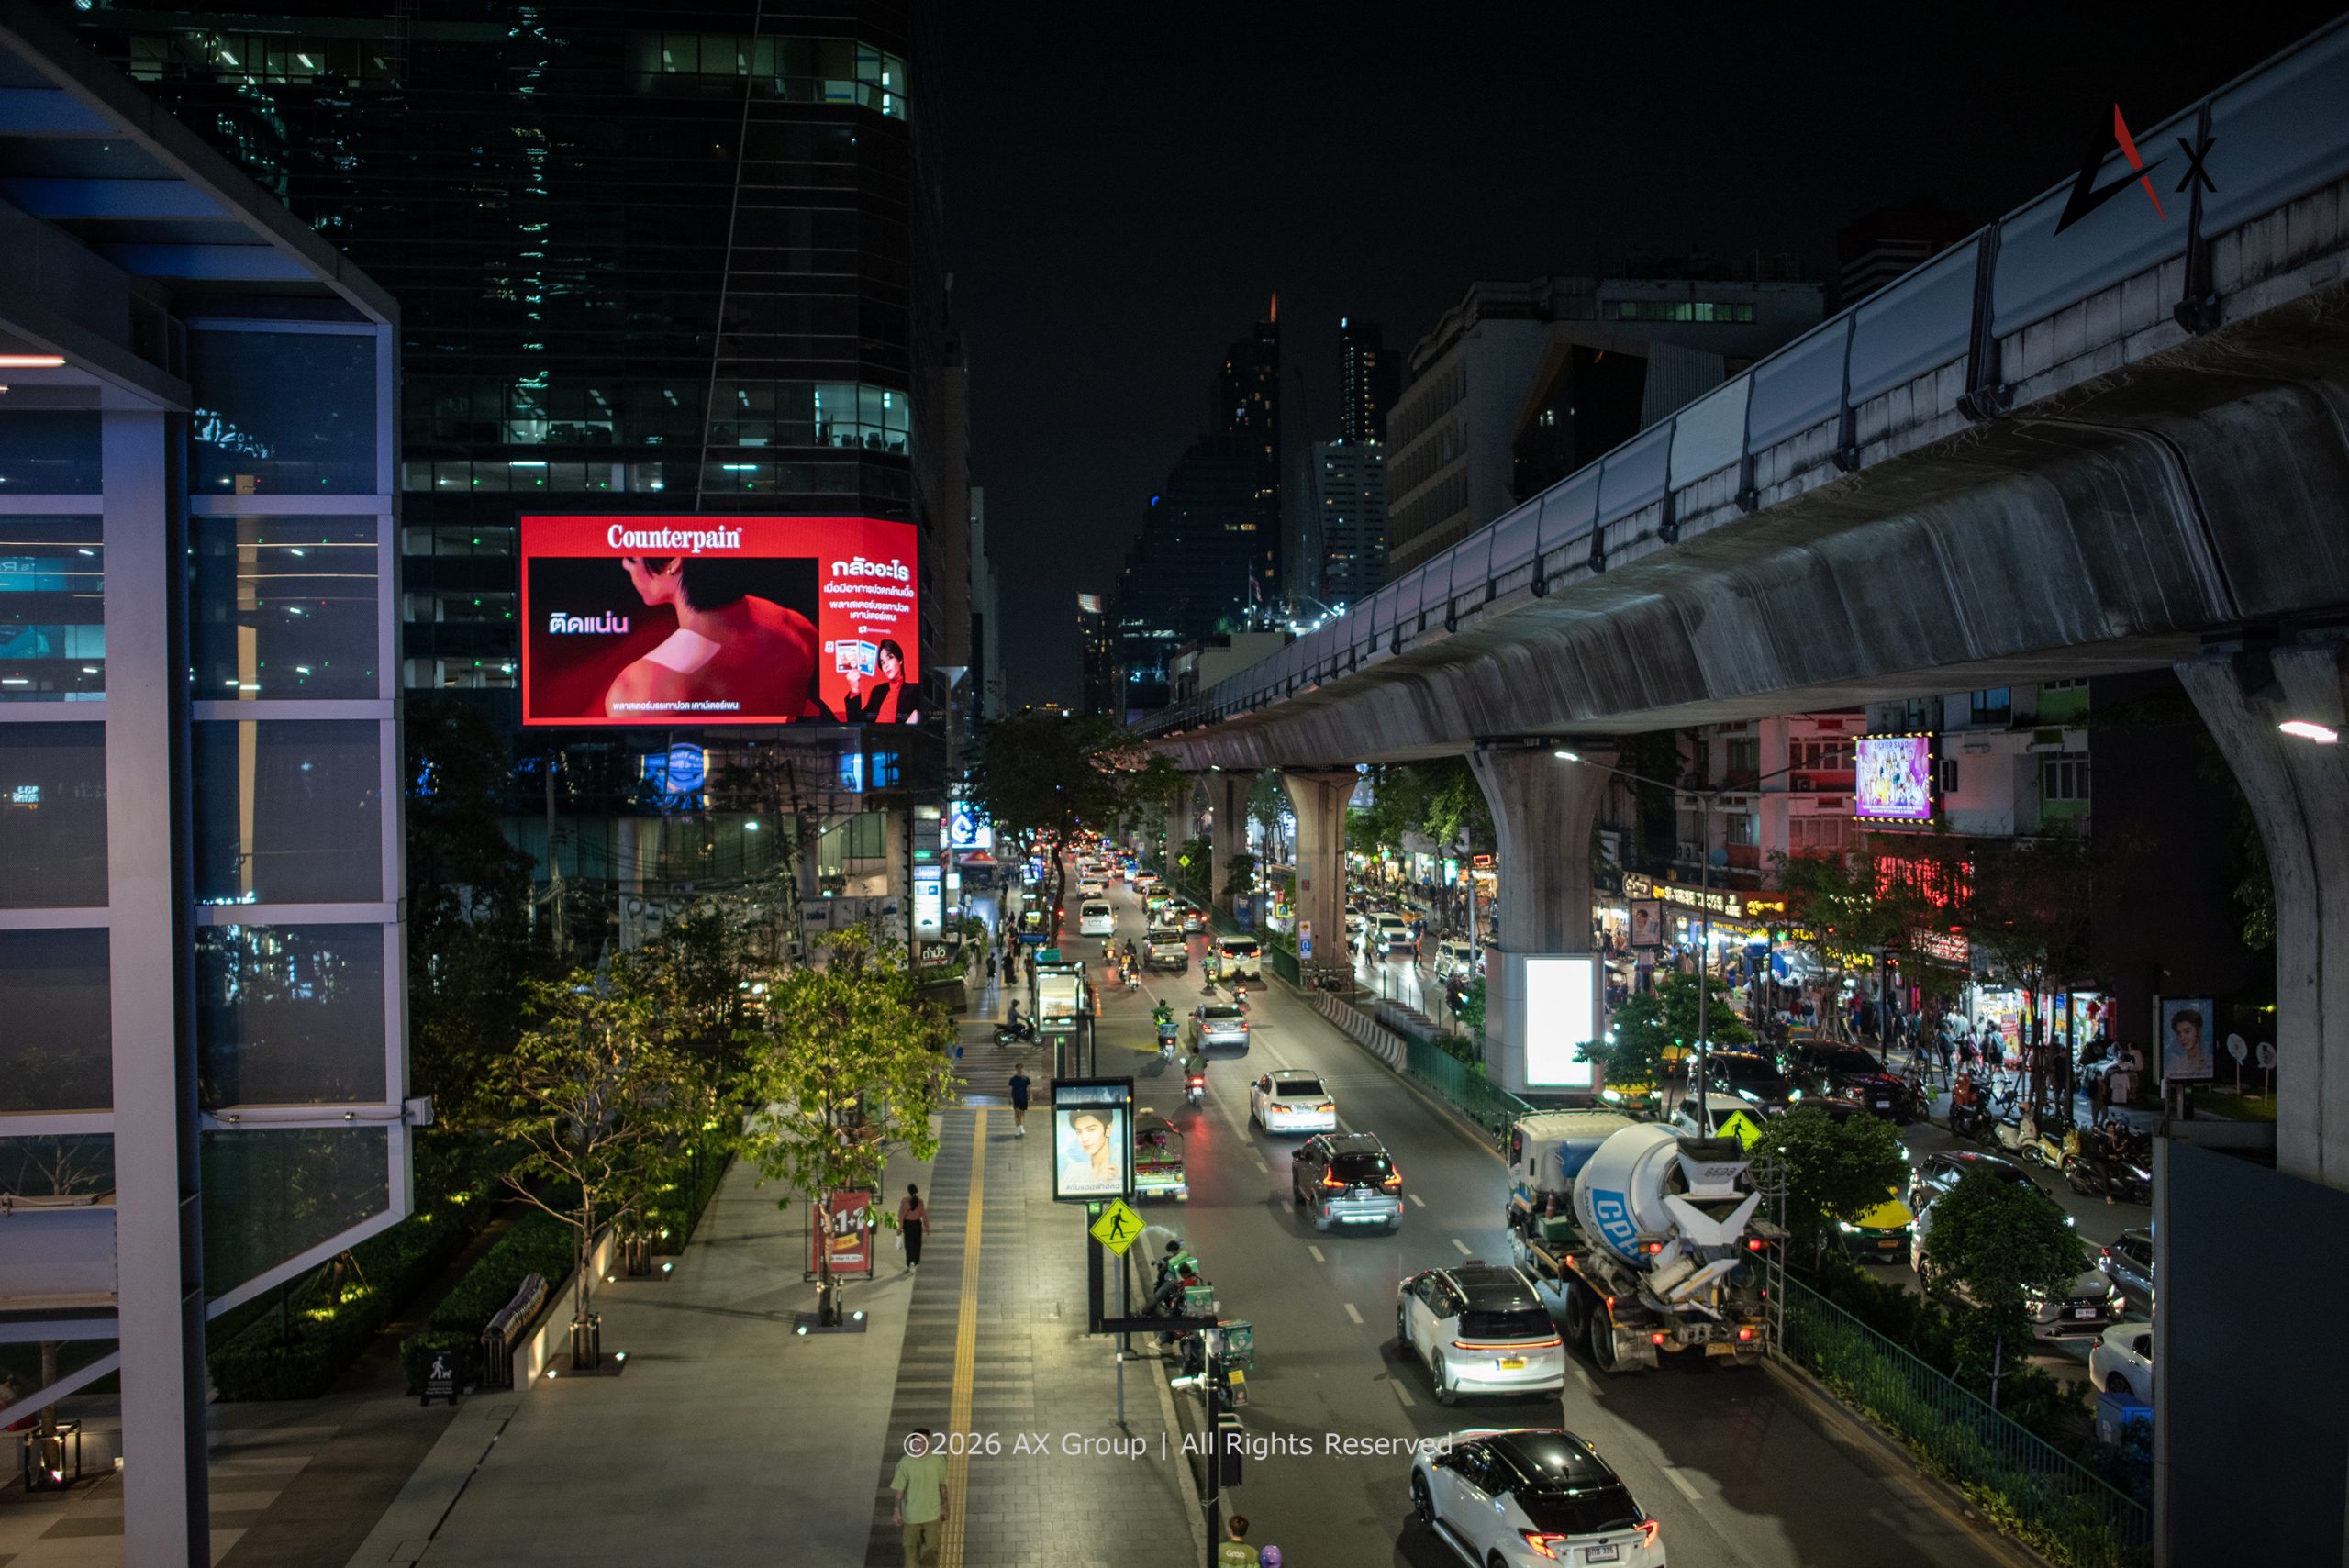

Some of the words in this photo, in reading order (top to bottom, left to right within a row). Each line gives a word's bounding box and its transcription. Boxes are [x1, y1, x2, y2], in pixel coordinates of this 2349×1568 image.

[607, 524, 740, 553] Counterpain
[831, 556, 909, 581] กลัวอะไร
[549, 610, 629, 634] ติดแน่น
[1597, 1200, 1650, 1263] CPA
[1225, 1549, 1246, 1559] Grab
